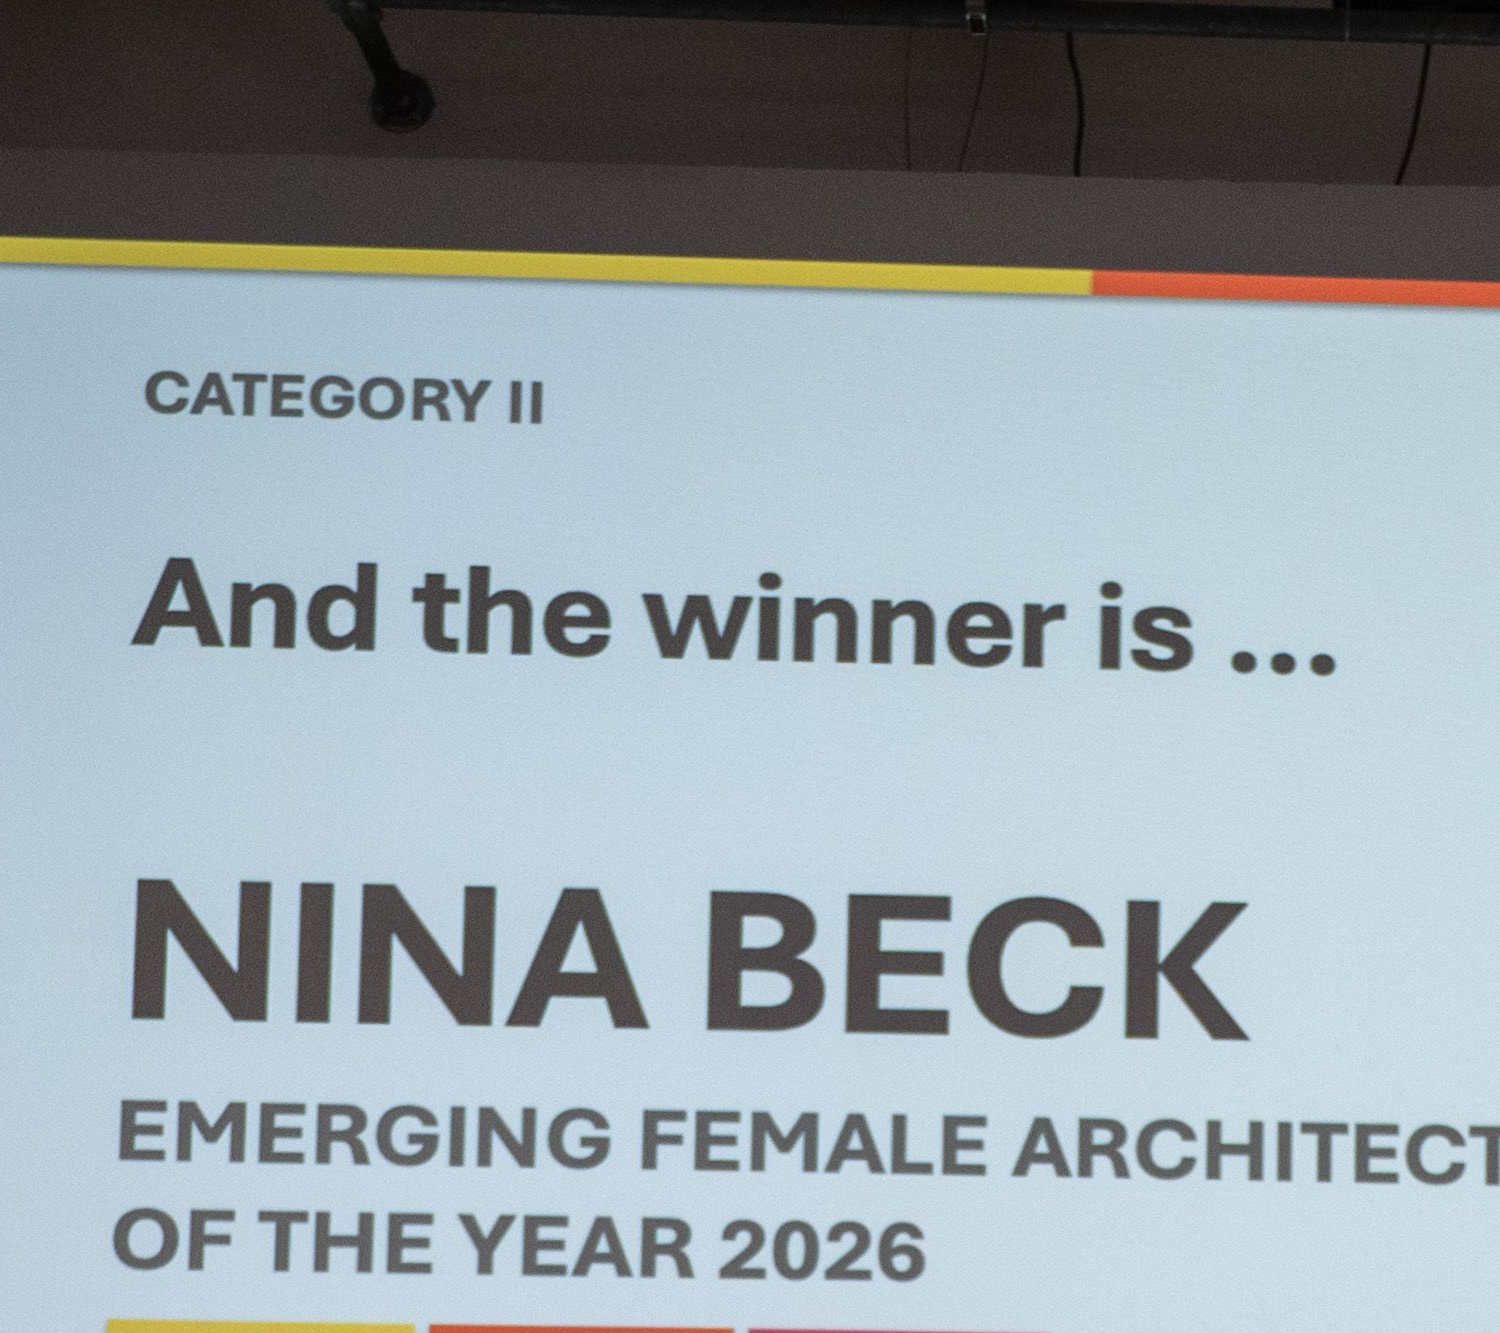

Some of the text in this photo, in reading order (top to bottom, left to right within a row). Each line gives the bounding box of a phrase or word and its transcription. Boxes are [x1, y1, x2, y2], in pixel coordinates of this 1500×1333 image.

[144, 370, 546, 425] CATEGORY II
[130, 556, 380, 650] And
[412, 564, 612, 659] the
[641, 571, 1065, 669] winner
[1097, 582, 1195, 675] is
[130, 877, 1251, 1042] NINA BECK
[115, 1097, 612, 1171] EMERGING
[640, 1107, 987, 1177] FEMALE
[110, 1207, 928, 1285] OF THE YEAR 2026
